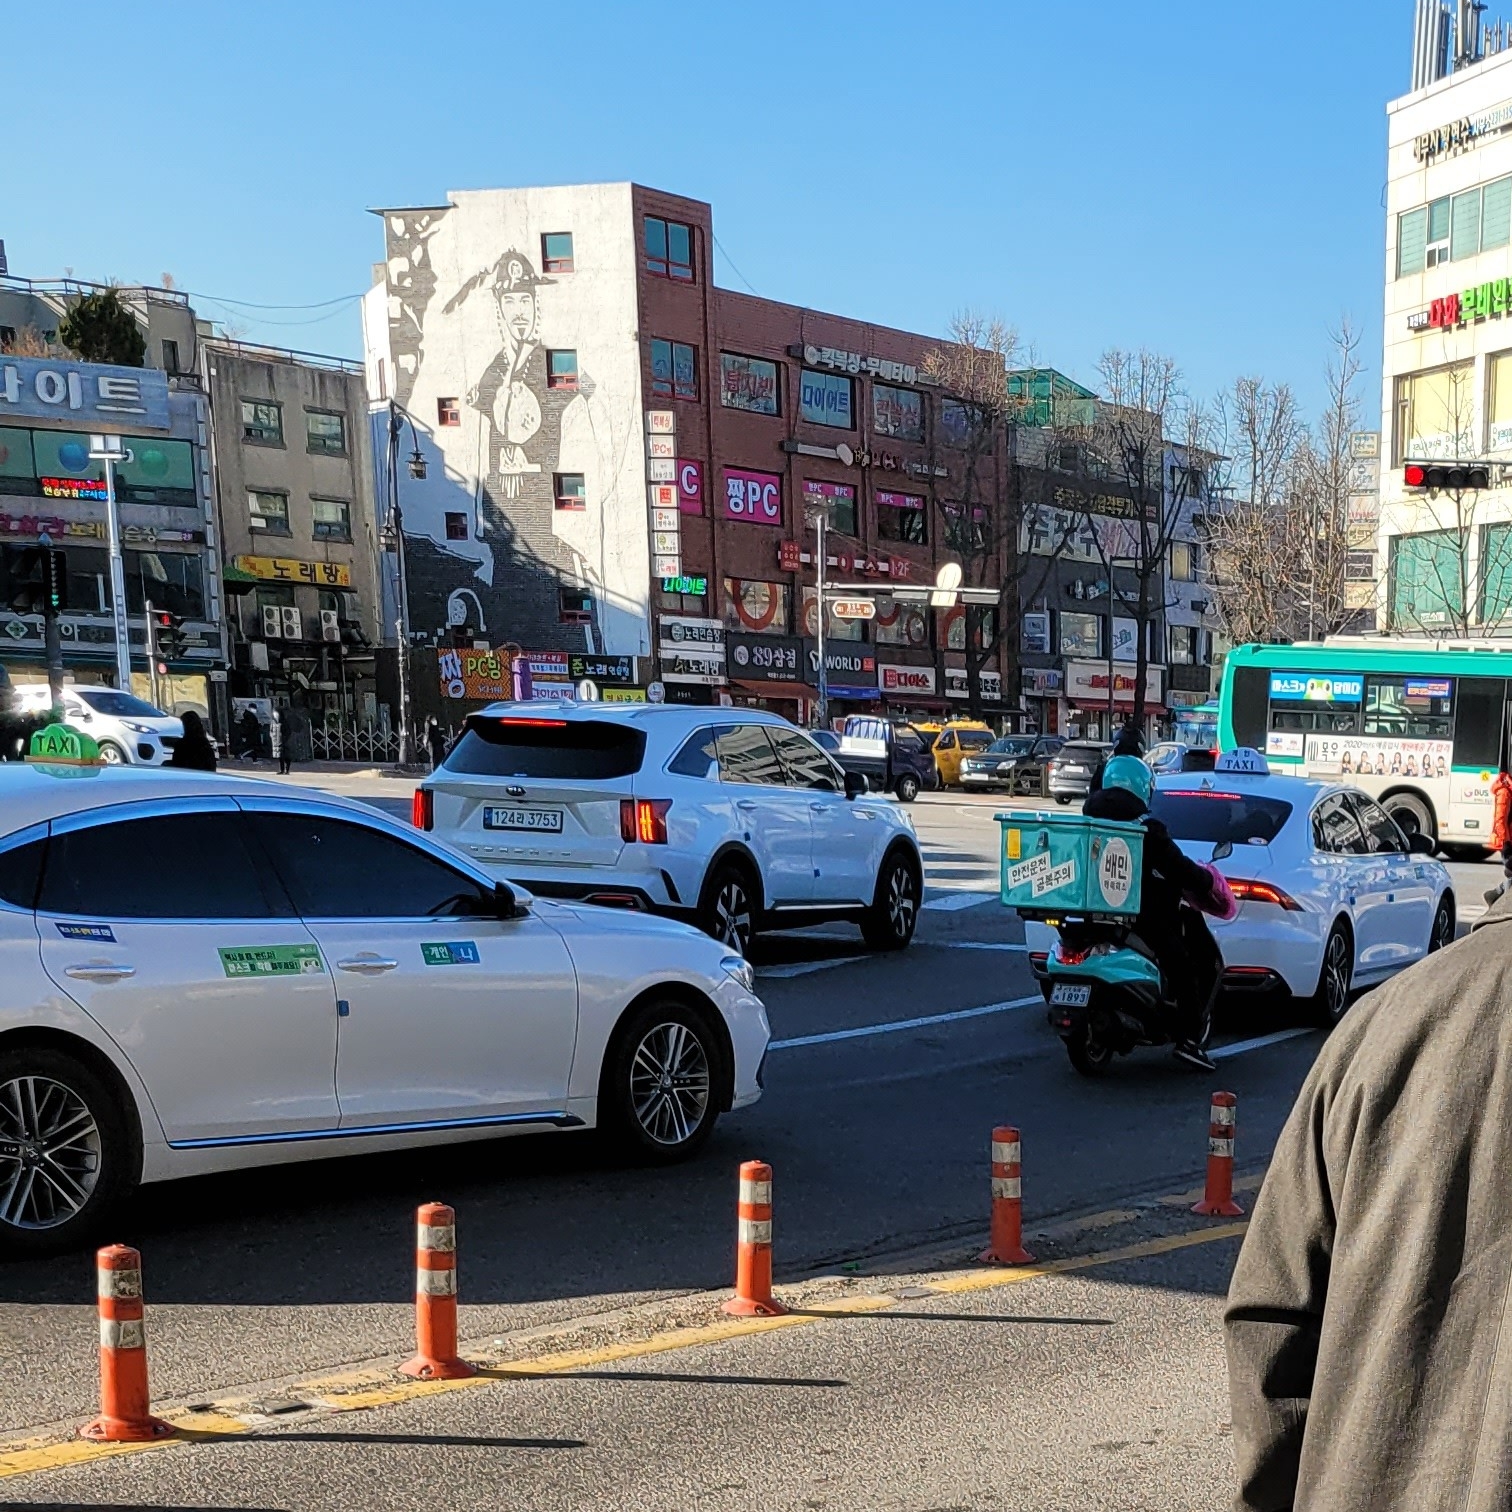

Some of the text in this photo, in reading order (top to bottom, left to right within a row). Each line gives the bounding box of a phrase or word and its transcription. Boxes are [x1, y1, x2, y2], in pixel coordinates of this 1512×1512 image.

[726, 477, 779, 518] 짱PC
[272, 559, 340, 584] 노래방
[689, 658, 721, 676] 노래방
[825, 654, 861, 672] WORLD
[37, 734, 75, 754] TAXI
[1224, 759, 1255, 771] TAXI
[1473, 788, 1490, 797] BUS
[493, 810, 558, 828] 124라 3753
[1011, 856, 1047, 883] 안전운전
[1104, 852, 1128, 881] 배민
[430, 946, 449, 959] 개인
